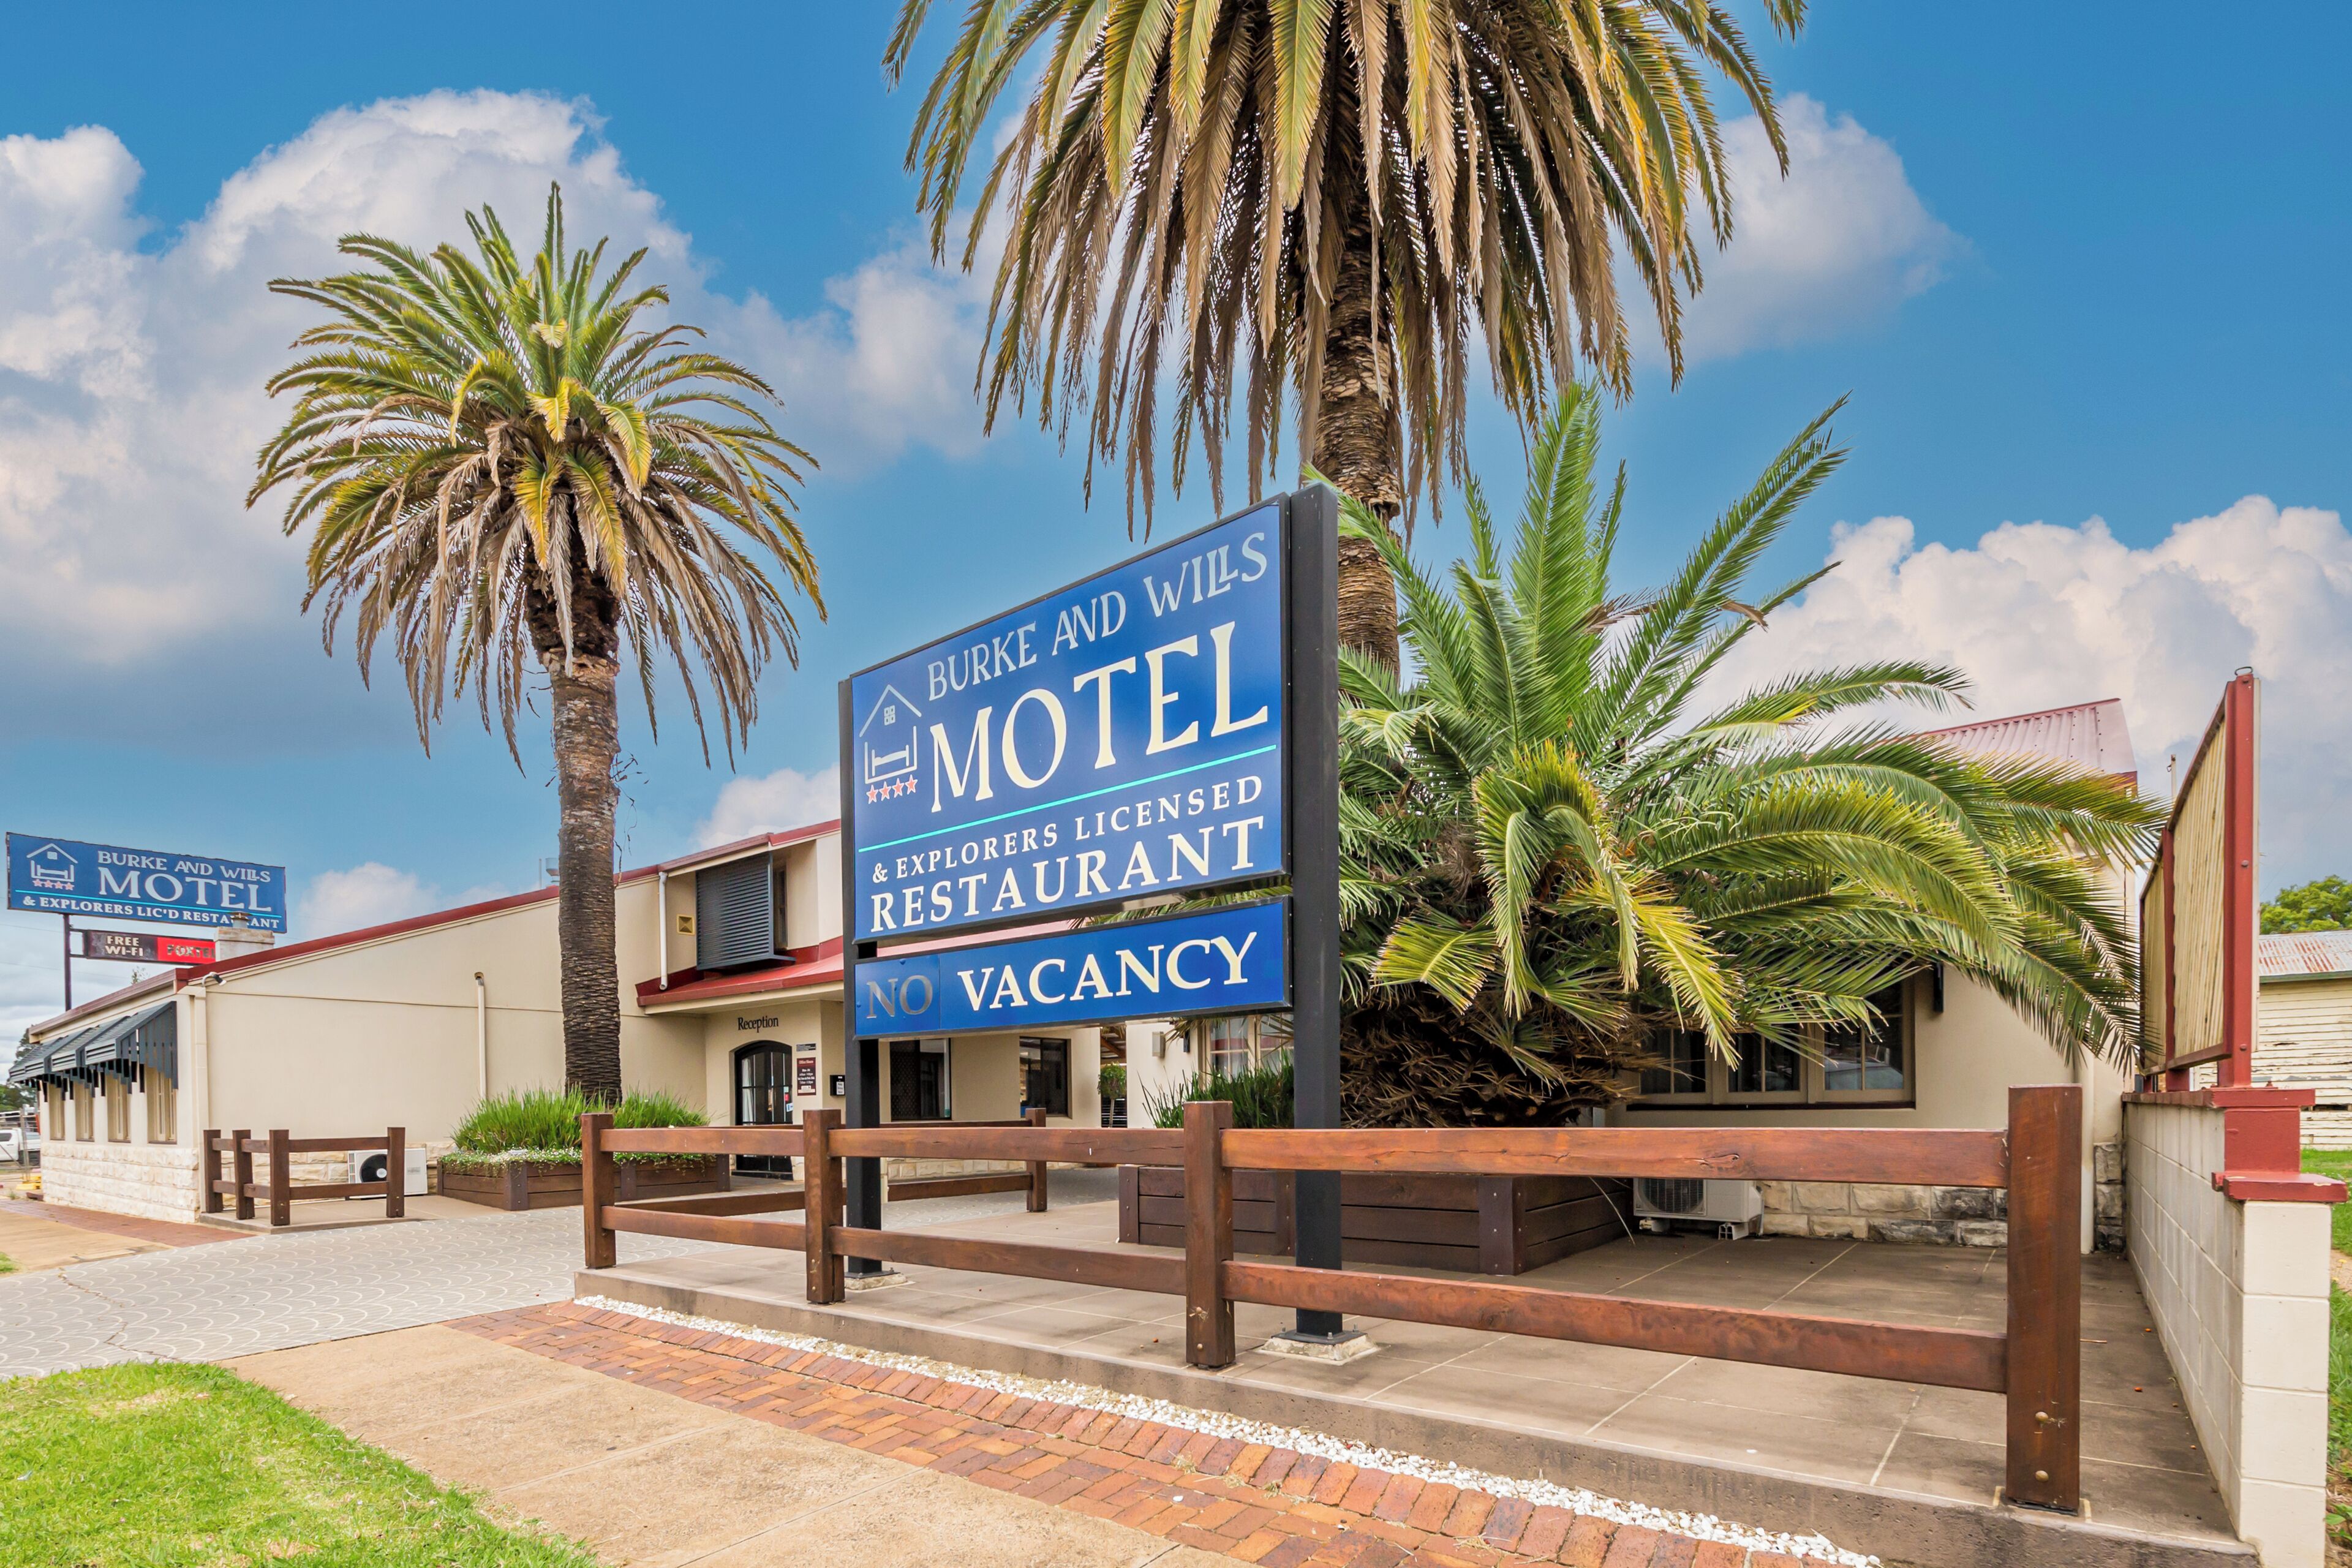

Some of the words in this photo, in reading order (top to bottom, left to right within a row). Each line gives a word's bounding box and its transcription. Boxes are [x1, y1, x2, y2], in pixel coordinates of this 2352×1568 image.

[927, 621, 1038, 701] BURKE
[1052, 590, 1126, 656] AND
[1143, 532, 1268, 617] WILLS
[929, 620, 1268, 813] MOTEL
[872, 862, 889, 884] &
[895, 823, 1058, 880] EXPLORERS
[1074, 774, 1264, 842] LICENSED
[97, 850, 167, 870] BURKE
[174, 861, 213, 875] AND
[220, 865, 271, 883] WILLS
[870, 815, 1264, 933] RESTAURANT
[23, 895, 36, 906] &
[39, 897, 134, 915] EXPLORERS
[137, 906, 179, 919] LIC'D
[182, 910, 279, 929] RESTAANT
[97, 867, 272, 912] MOTEL
[105, 945, 144, 957] WI-FI
[107, 935, 140, 946] FREE
[866, 974, 933, 1019] NO
[956, 931, 1257, 1011] VACANCY
[737, 1016, 779, 1033] Reception
